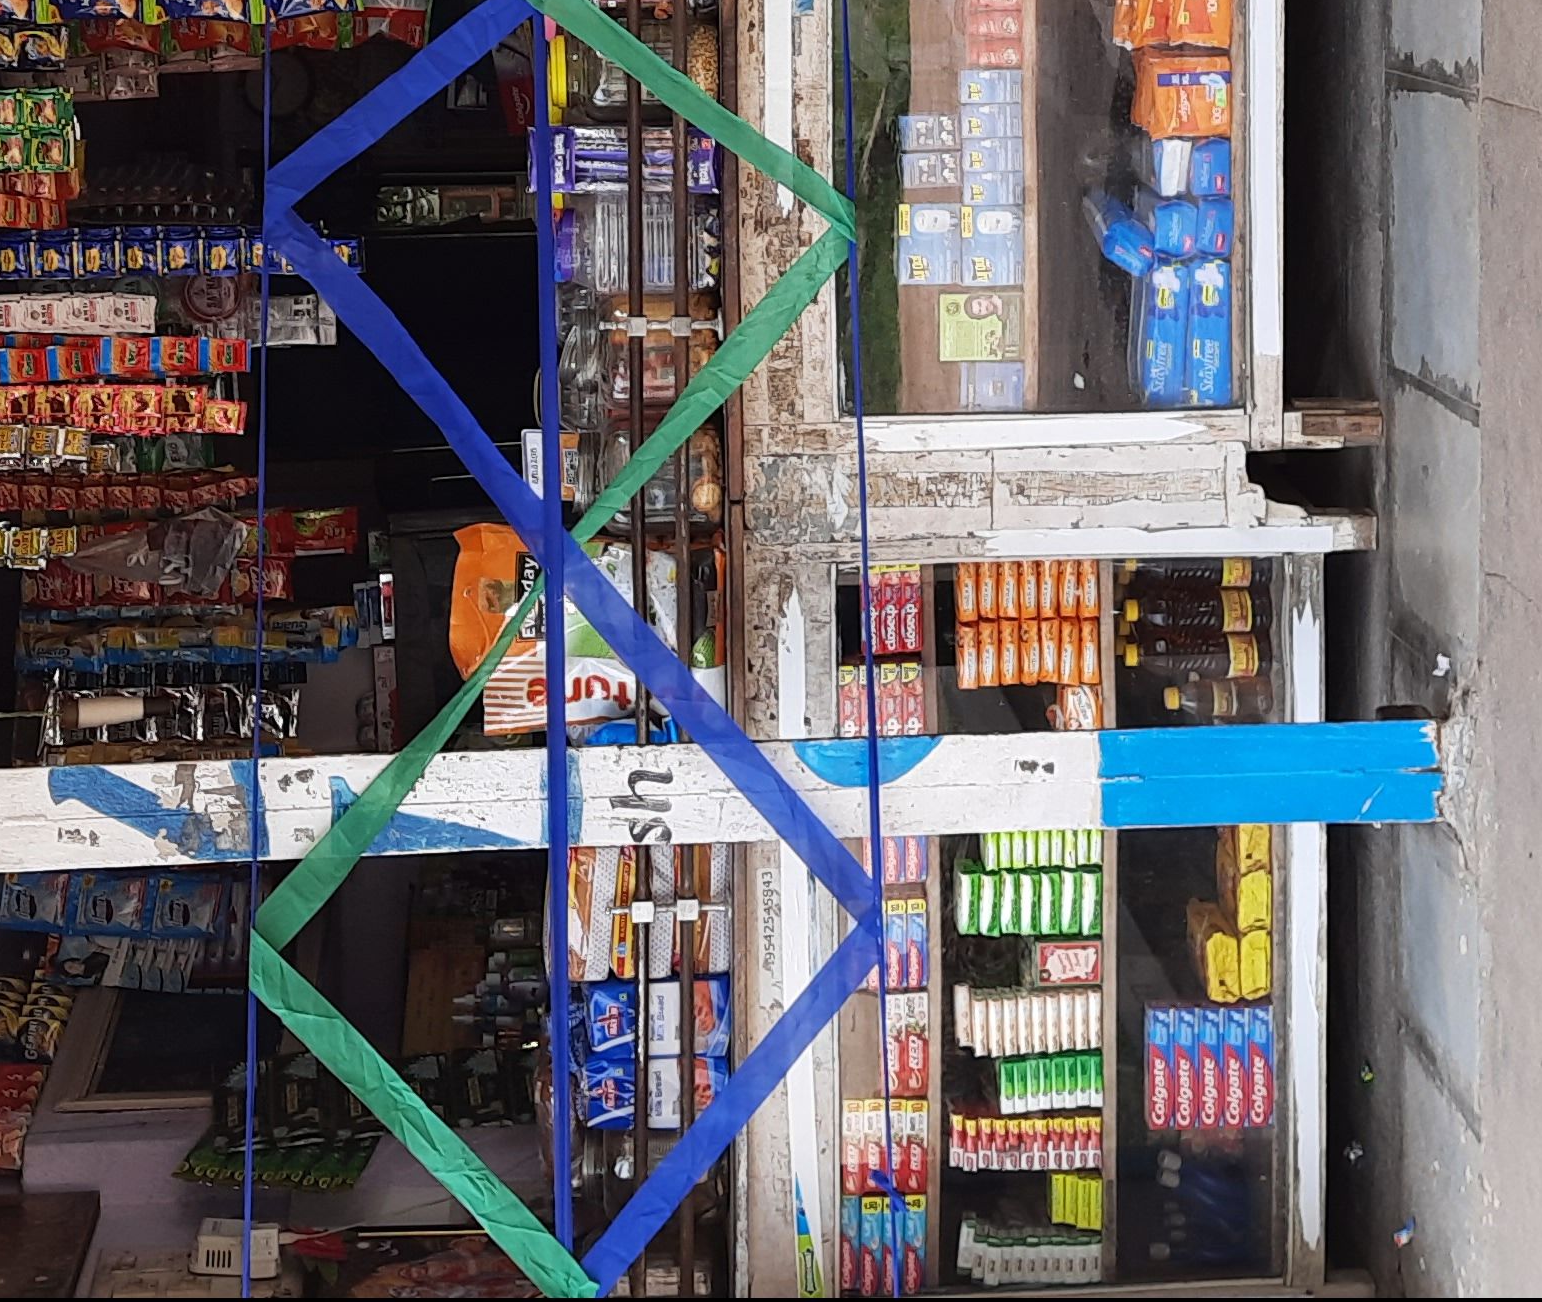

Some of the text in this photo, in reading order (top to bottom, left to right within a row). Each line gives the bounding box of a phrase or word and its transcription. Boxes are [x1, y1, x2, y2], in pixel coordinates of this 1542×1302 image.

[1149, 340, 1170, 395] Stayfree
[1198, 339, 1216, 395] Stayfree
[526, 447, 539, 485] amazon
[884, 603, 899, 650] closeup
[905, 602, 919, 649] closeup
[885, 837, 900, 881] Colgate
[907, 837, 920, 881] Colgate
[888, 946, 901, 987] Colgate
[909, 945, 921, 987] Colgate
[23, 1020, 39, 1059] GEMINI
[908, 1034, 920, 1069] RED
[1151, 1057, 1168, 1125] Colgate
[1176, 1058, 1194, 1126] Colgate
[1201, 1057, 1218, 1125] Colgate
[1225, 1057, 1243, 1125] Colgate
[1251, 1055, 1268, 1124] Colgate
[863, 1253, 873, 1296] Colgate
